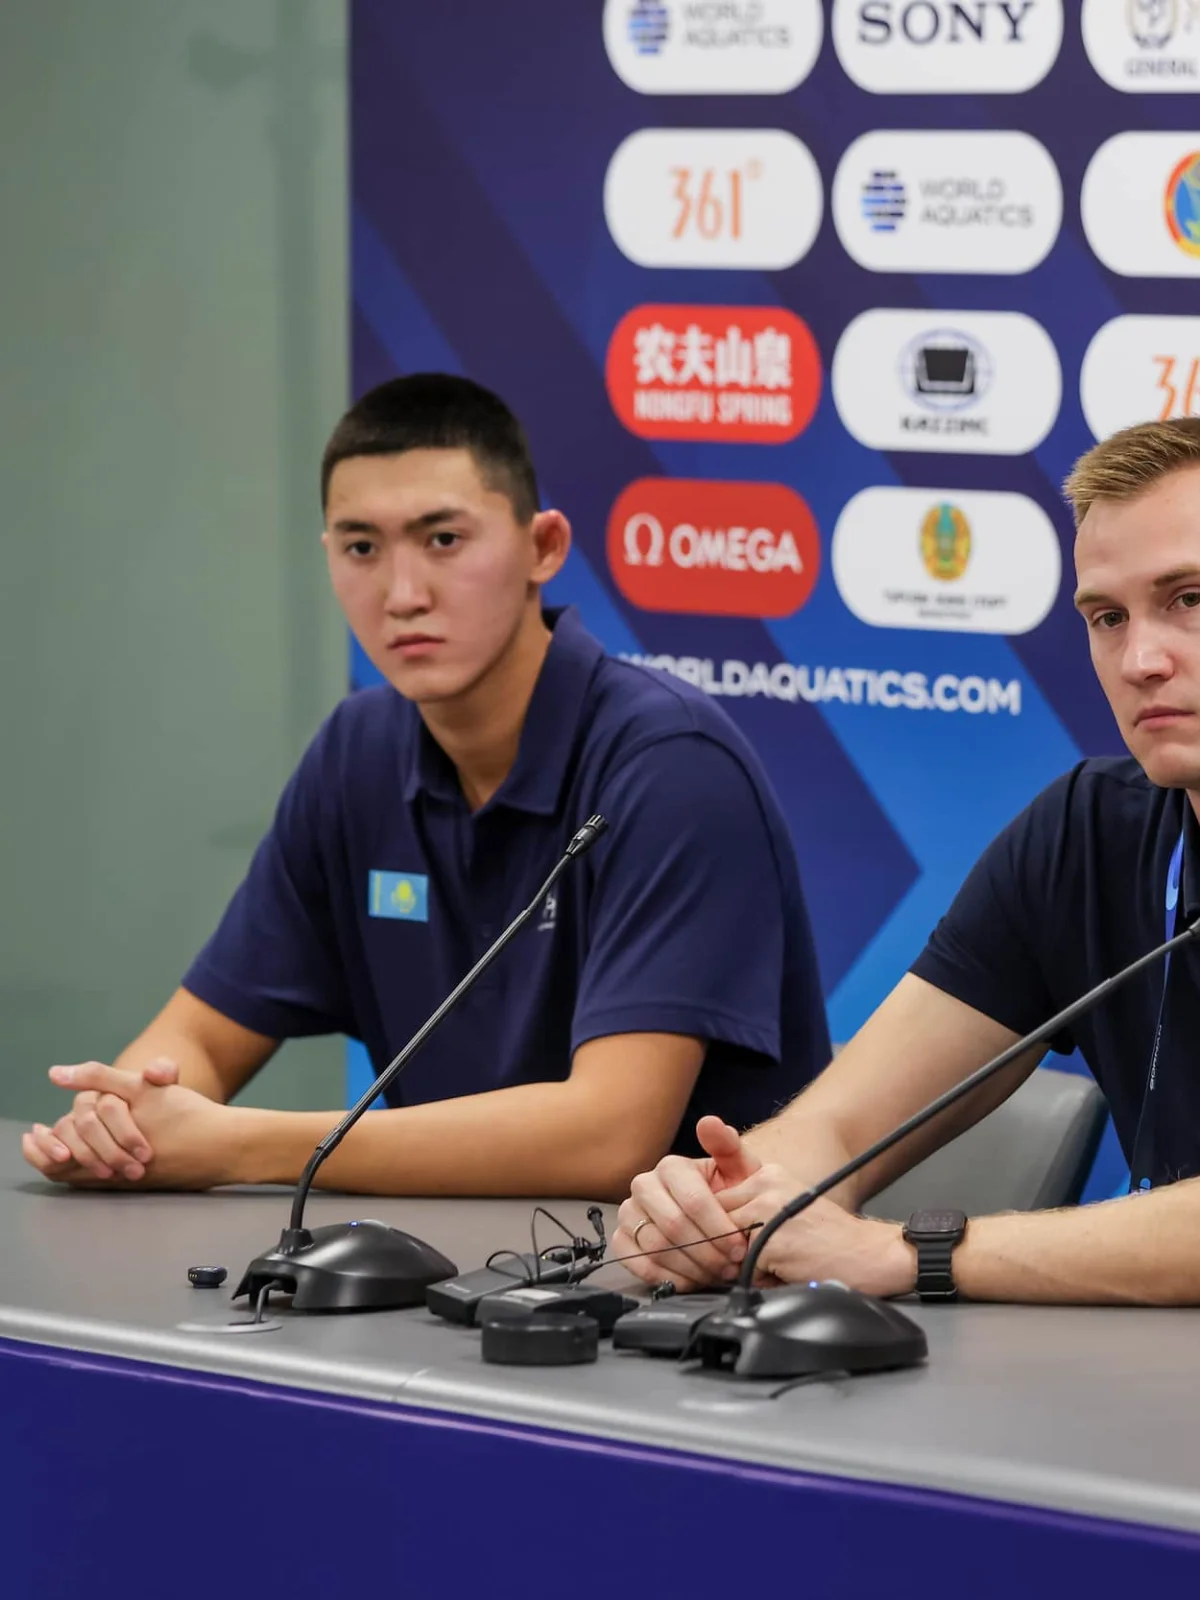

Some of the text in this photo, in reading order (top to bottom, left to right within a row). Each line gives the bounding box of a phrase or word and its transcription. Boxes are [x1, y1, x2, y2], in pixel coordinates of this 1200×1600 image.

[683, 27, 790, 47] AQUATICS
[858, 2, 1034, 44] SONY
[1125, 58, 1197, 77] GENERAL
[919, 179, 1005, 199] WORLD
[920, 205, 1034, 228] AQUATICS
[634, 323, 793, 389] 农夫山泉
[634, 389, 793, 426] NONGFU SPRING
[669, 523, 804, 573] OMEGA
